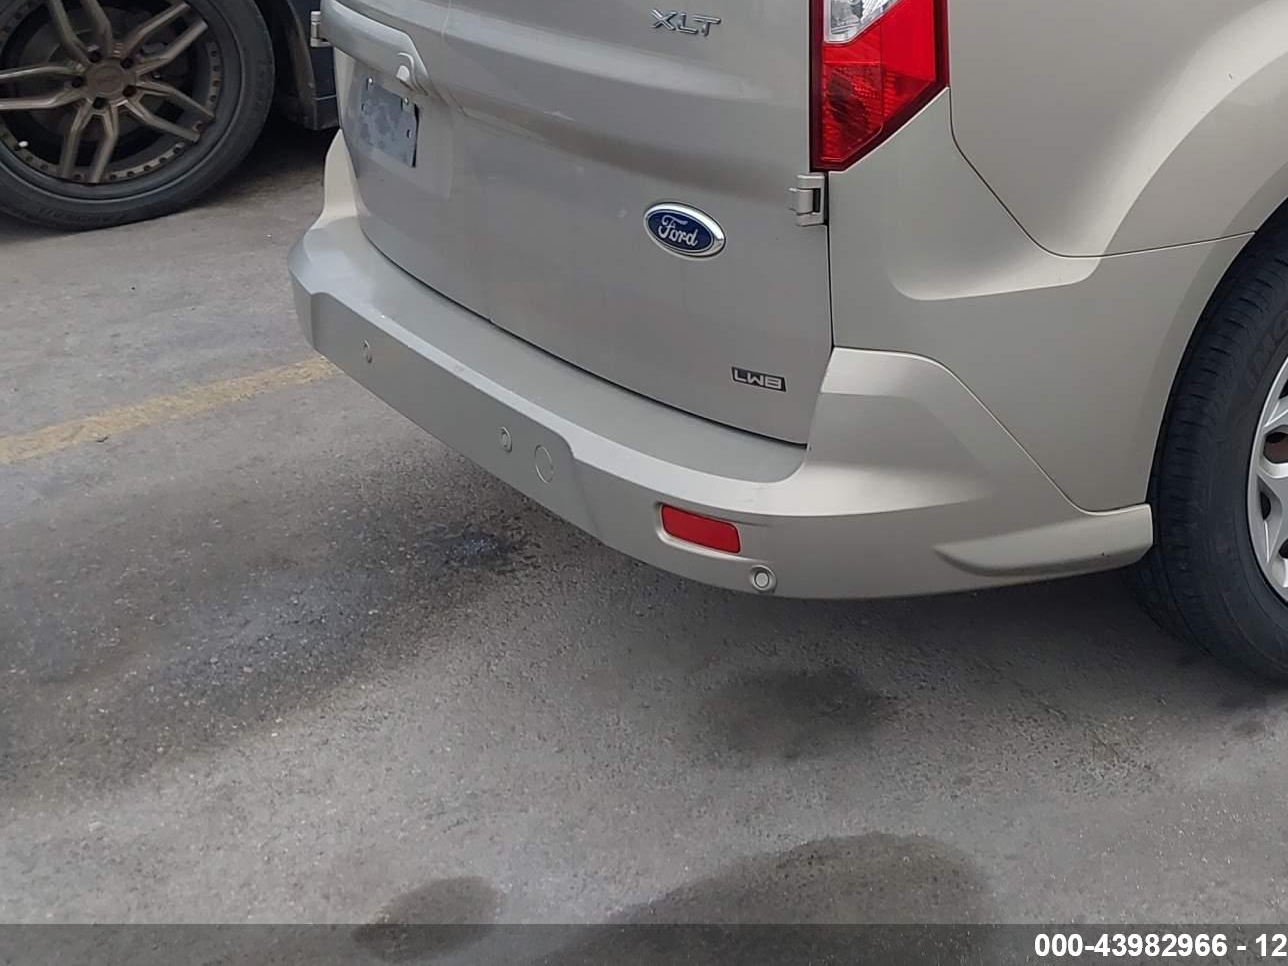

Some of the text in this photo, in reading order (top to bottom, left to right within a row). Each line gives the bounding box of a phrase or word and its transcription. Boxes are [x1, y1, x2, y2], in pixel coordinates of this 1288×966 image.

[650, 9, 722, 36] XLT
[658, 214, 699, 246] Ford
[734, 369, 782, 390] LWB
